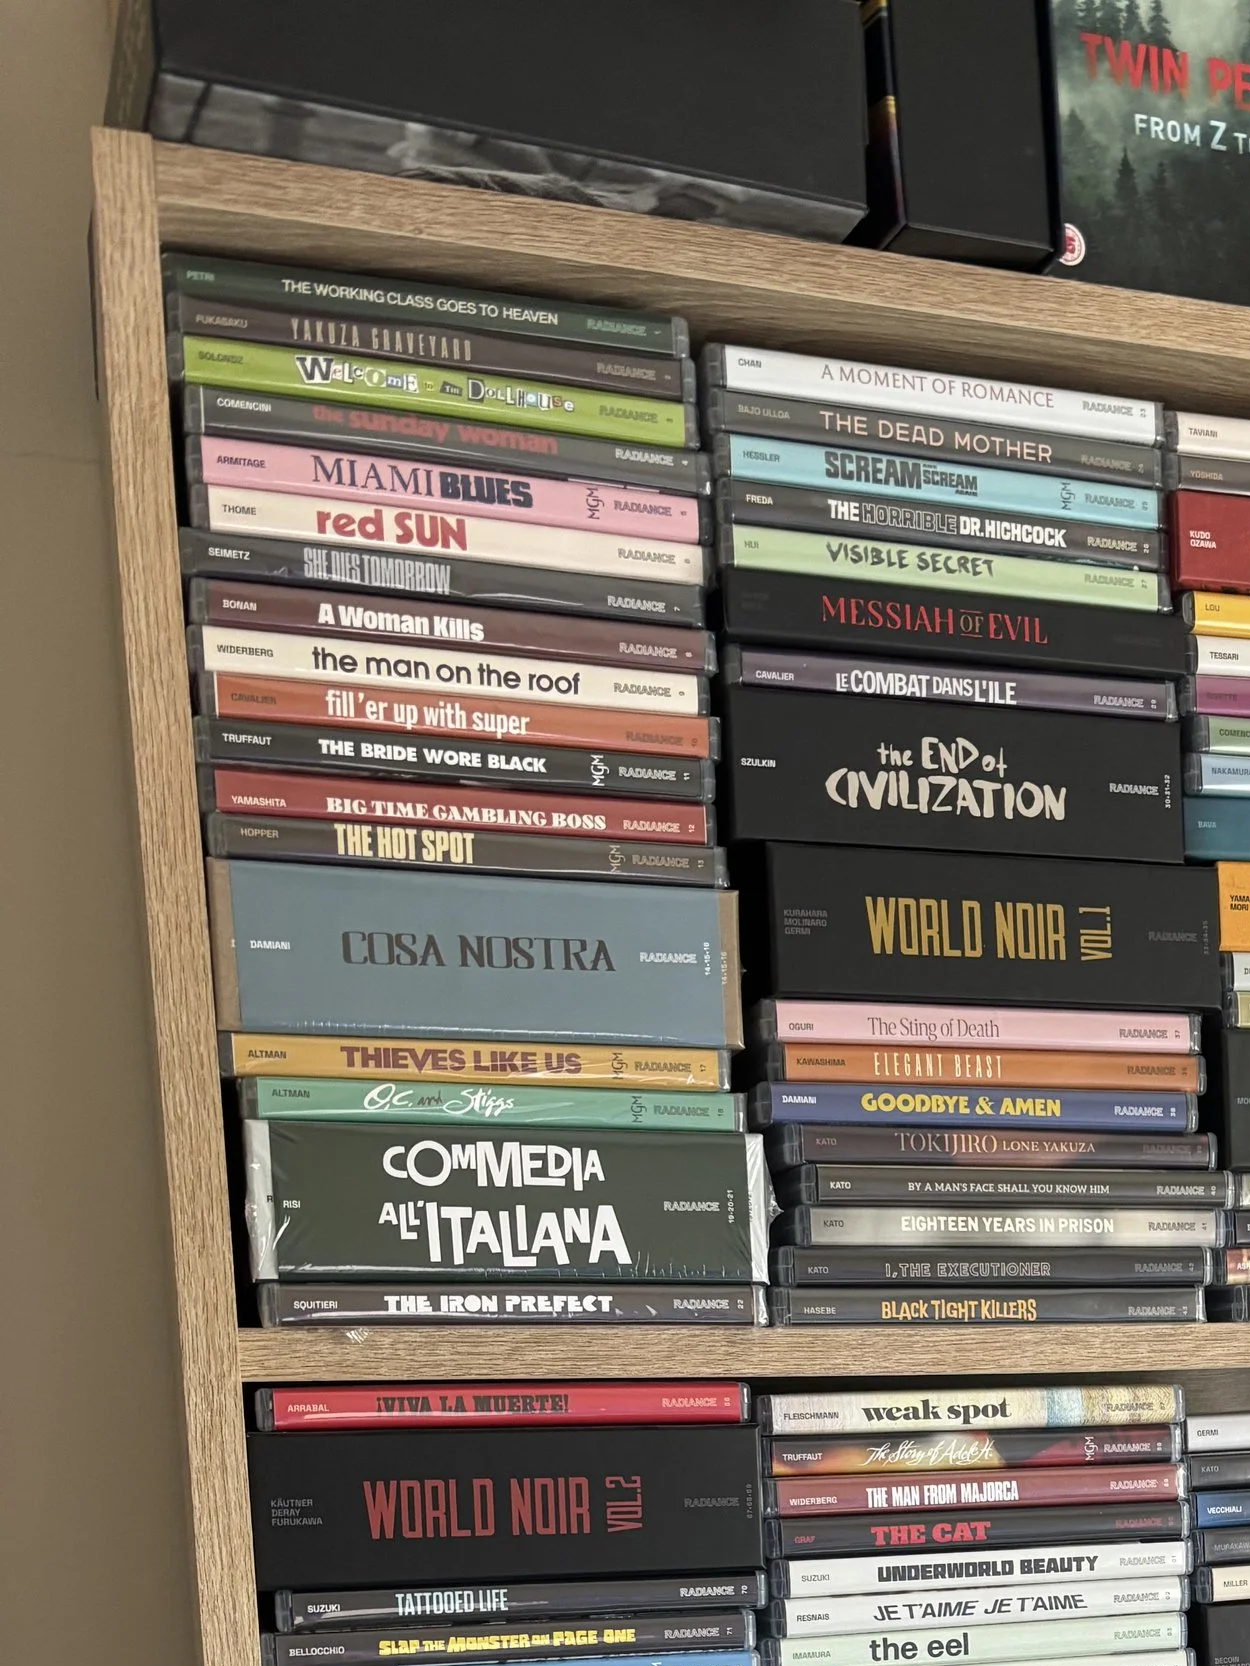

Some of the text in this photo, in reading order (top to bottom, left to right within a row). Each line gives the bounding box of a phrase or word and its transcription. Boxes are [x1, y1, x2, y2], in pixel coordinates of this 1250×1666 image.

[1079, 33, 1189, 97] TWIN
[1134, 113, 1201, 147] FROM
[1210, 120, 1227, 152] Z
[282, 280, 558, 325] THE WORKING CLASS GOES TO HEAVEN
[738, 358, 762, 368] CHAN
[822, 365, 1054, 408] A MOMENT OF ROMANCE
[222, 504, 257, 517] THOME
[316, 510, 468, 551] red SUN
[1190, 531, 1211, 540] KUDO
[1190, 539, 1216, 549] OZAWA
[1230, 903, 1249, 911] MORI
[866, 897, 1112, 961] WORLD NOIR VOL.1
[250, 939, 290, 952] DAMIANI
[342, 931, 616, 972] COSA NOSTRA
[640, 952, 697, 964] RADIANCE
[788, 1022, 814, 1031] OGURI
[382, 1140, 605, 1191] COMMEDIA
[901, 1216, 1113, 1234] EIGHTEEN YEARS IN PRISON
[294, 1300, 338, 1310] SQUITIERI
[861, 1398, 1012, 1425] weak spot
[1207, 1505, 1242, 1514] VECCHIALI
[289, 1645, 345, 1657] BELLOCCHIO
[869, 1633, 968, 1661] the eel
[792, 1650, 831, 1660] IMAMURA
